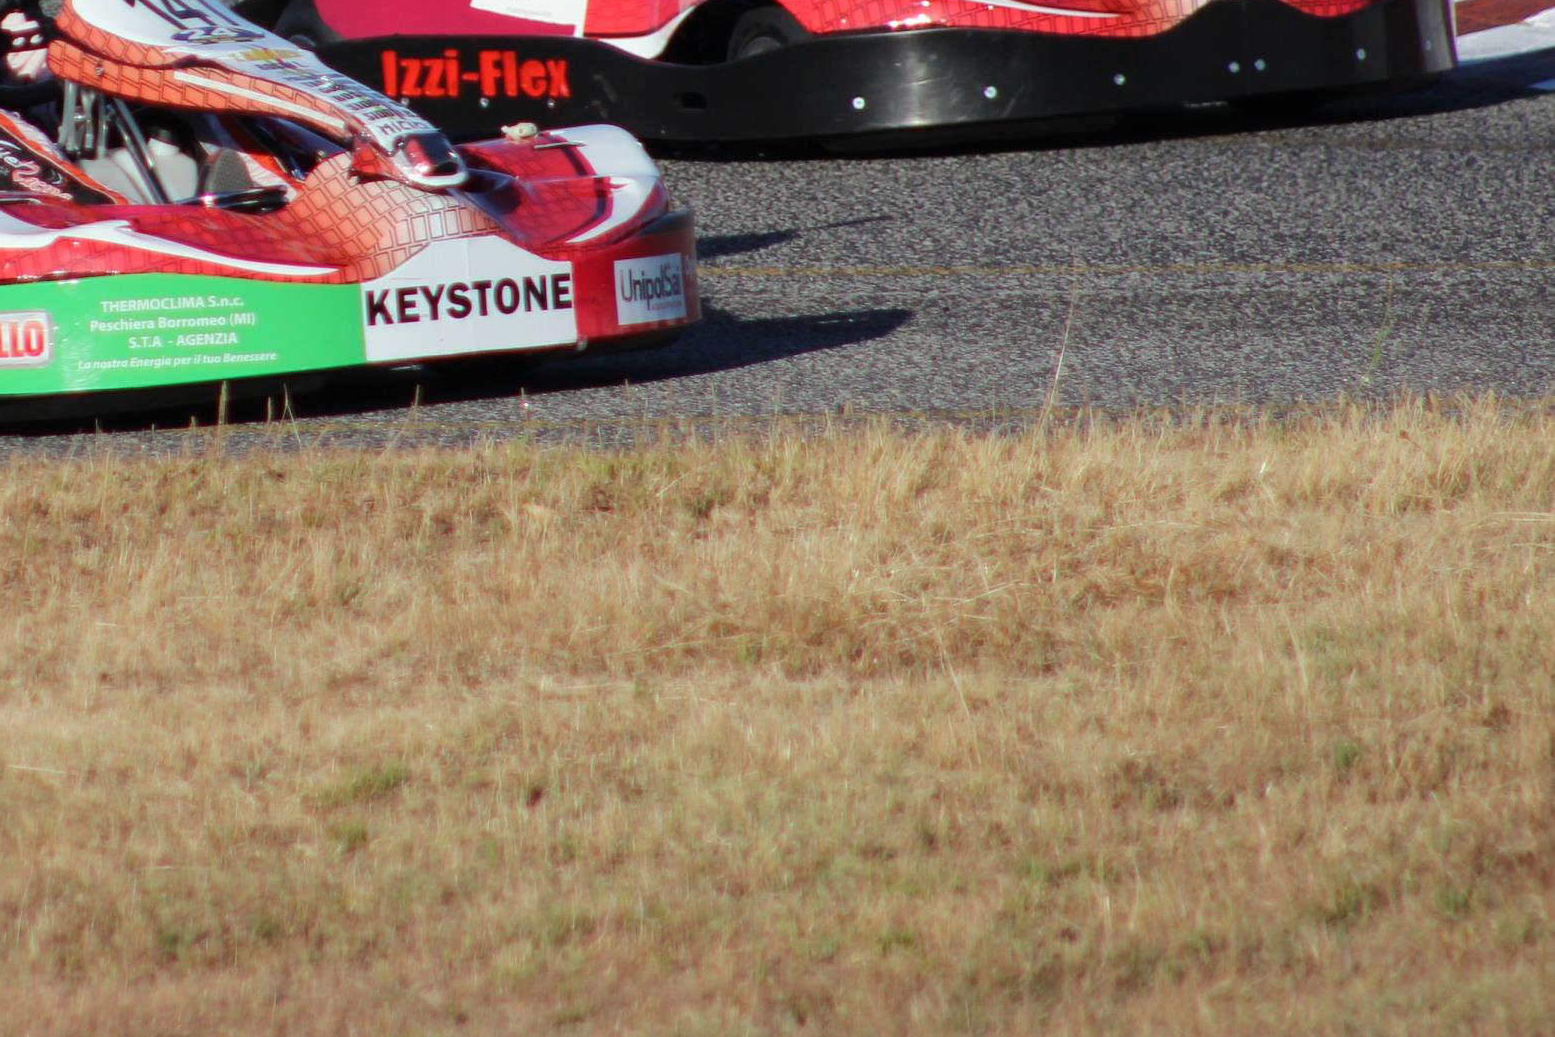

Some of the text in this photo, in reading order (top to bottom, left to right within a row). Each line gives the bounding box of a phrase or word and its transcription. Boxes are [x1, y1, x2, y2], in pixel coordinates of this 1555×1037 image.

[382, 48, 571, 98] Izzi-Flex
[620, 264, 681, 311] UnipolSai
[101, 296, 244, 313] THERMOCLIMA S.n.c.
[365, 273, 573, 327] KEYSTONE
[90, 313, 256, 332] Peschiera Borromeo (MI)
[176, 332, 238, 346] AGENZIA
[93, 358, 128, 369] nostra
[130, 355, 172, 369] Energia
[173, 355, 191, 367] per
[202, 354, 221, 364] tuo
[223, 351, 277, 363] Benessere
